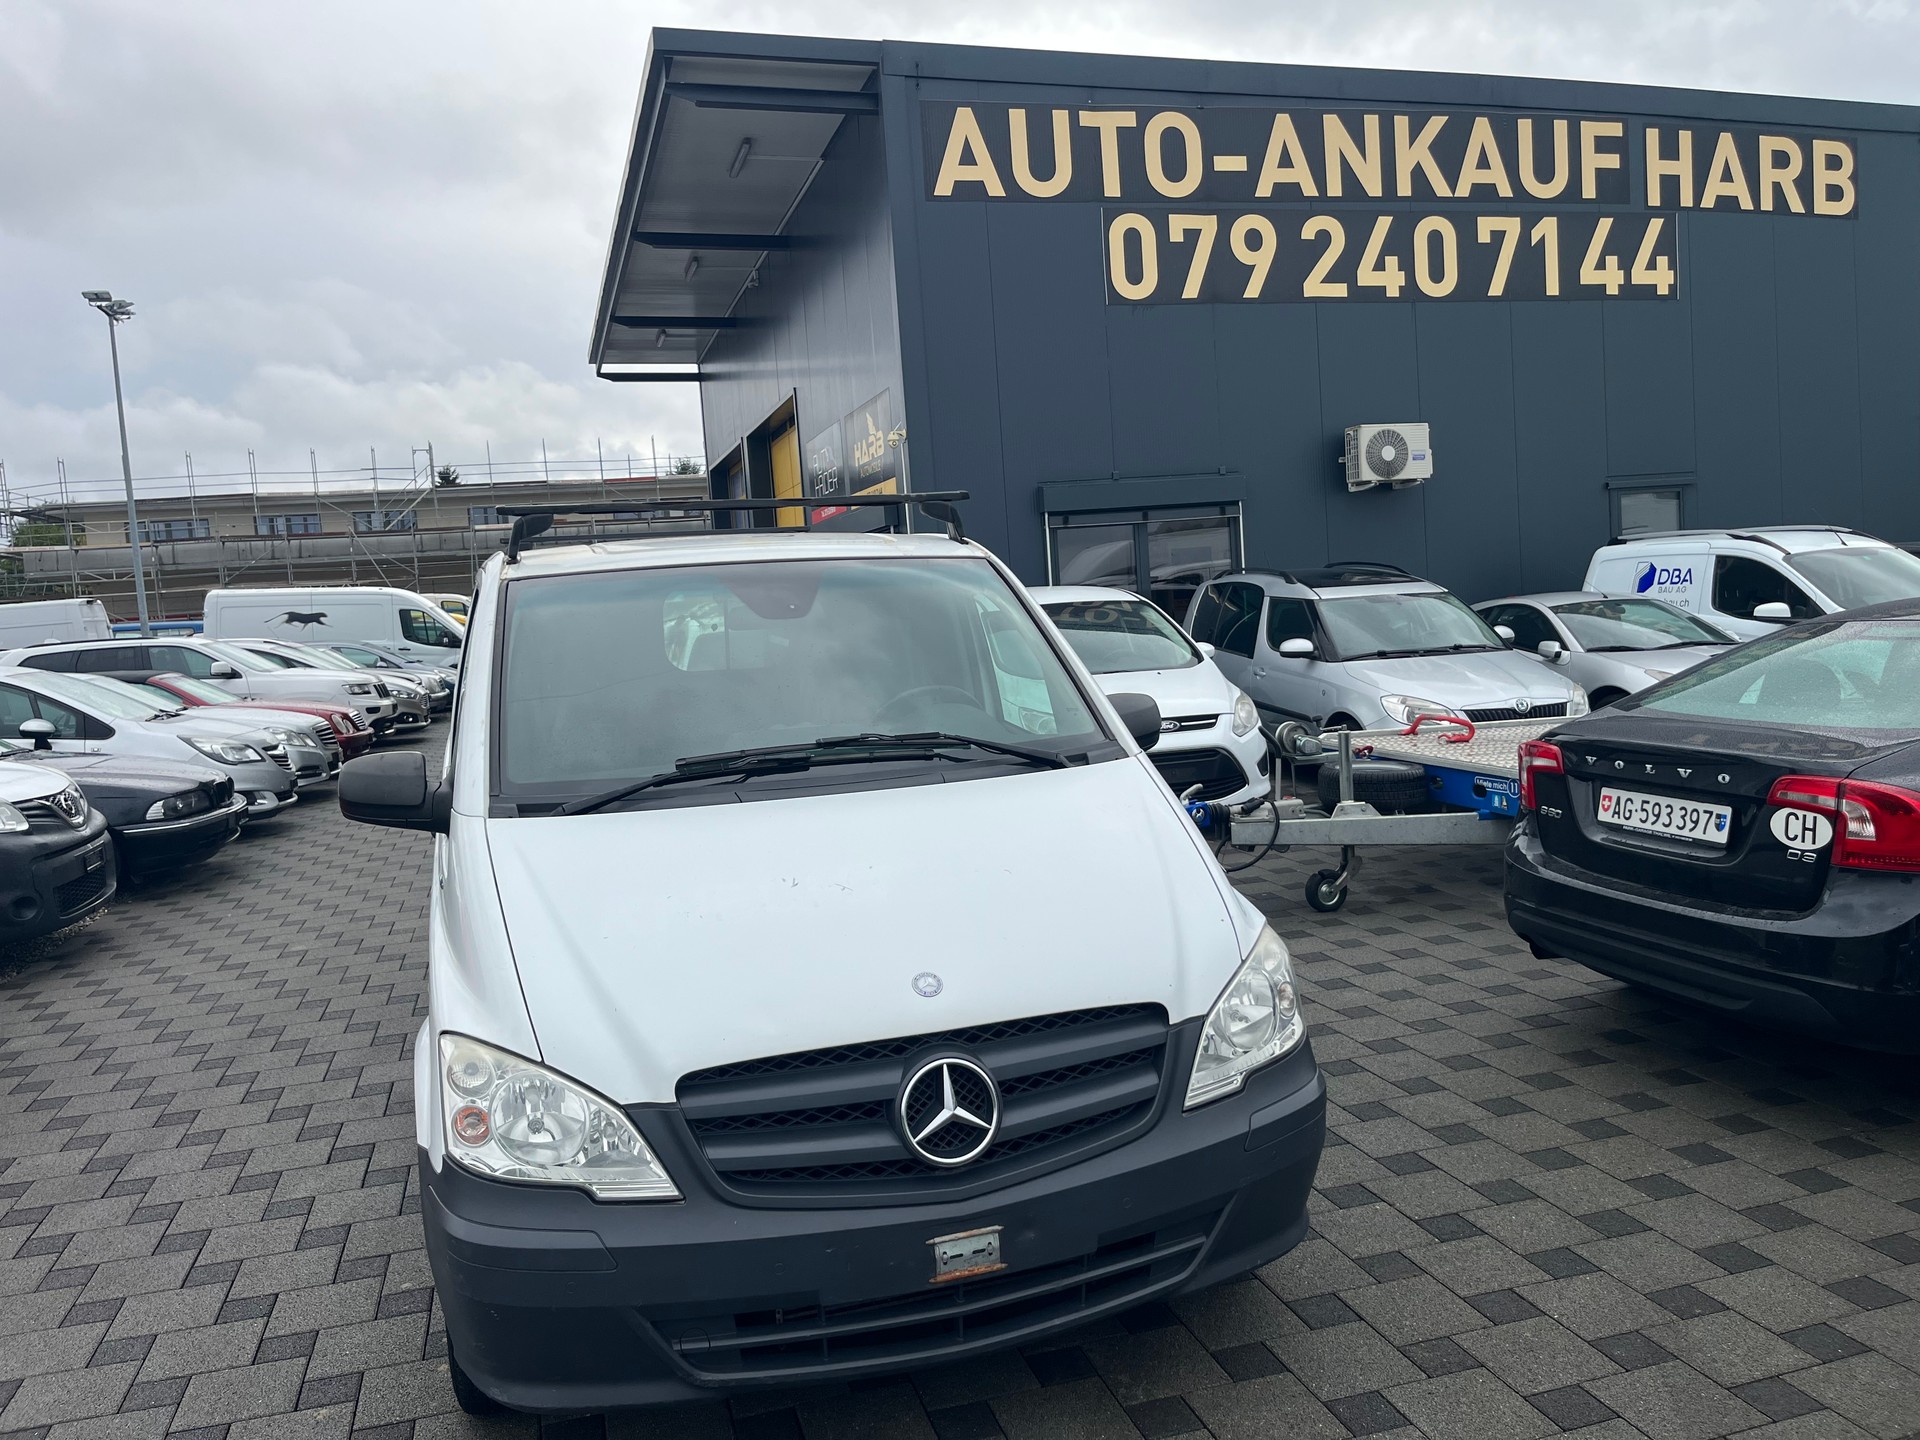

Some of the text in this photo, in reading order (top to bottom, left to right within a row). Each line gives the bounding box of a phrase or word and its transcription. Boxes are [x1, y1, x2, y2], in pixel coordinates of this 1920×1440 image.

[934, 107, 1855, 216] AUTO-ANKAUF HARB
[1108, 213, 1278, 301] 079
[1301, 215, 1459, 298] 240
[854, 430, 885, 467] HARB
[1657, 568, 1693, 585] DBA
[1657, 586, 1687, 594] BAU AG
[1585, 755, 1731, 784] VOLVO
[1784, 811, 1818, 845] CH
[1786, 849, 1817, 863] D3
